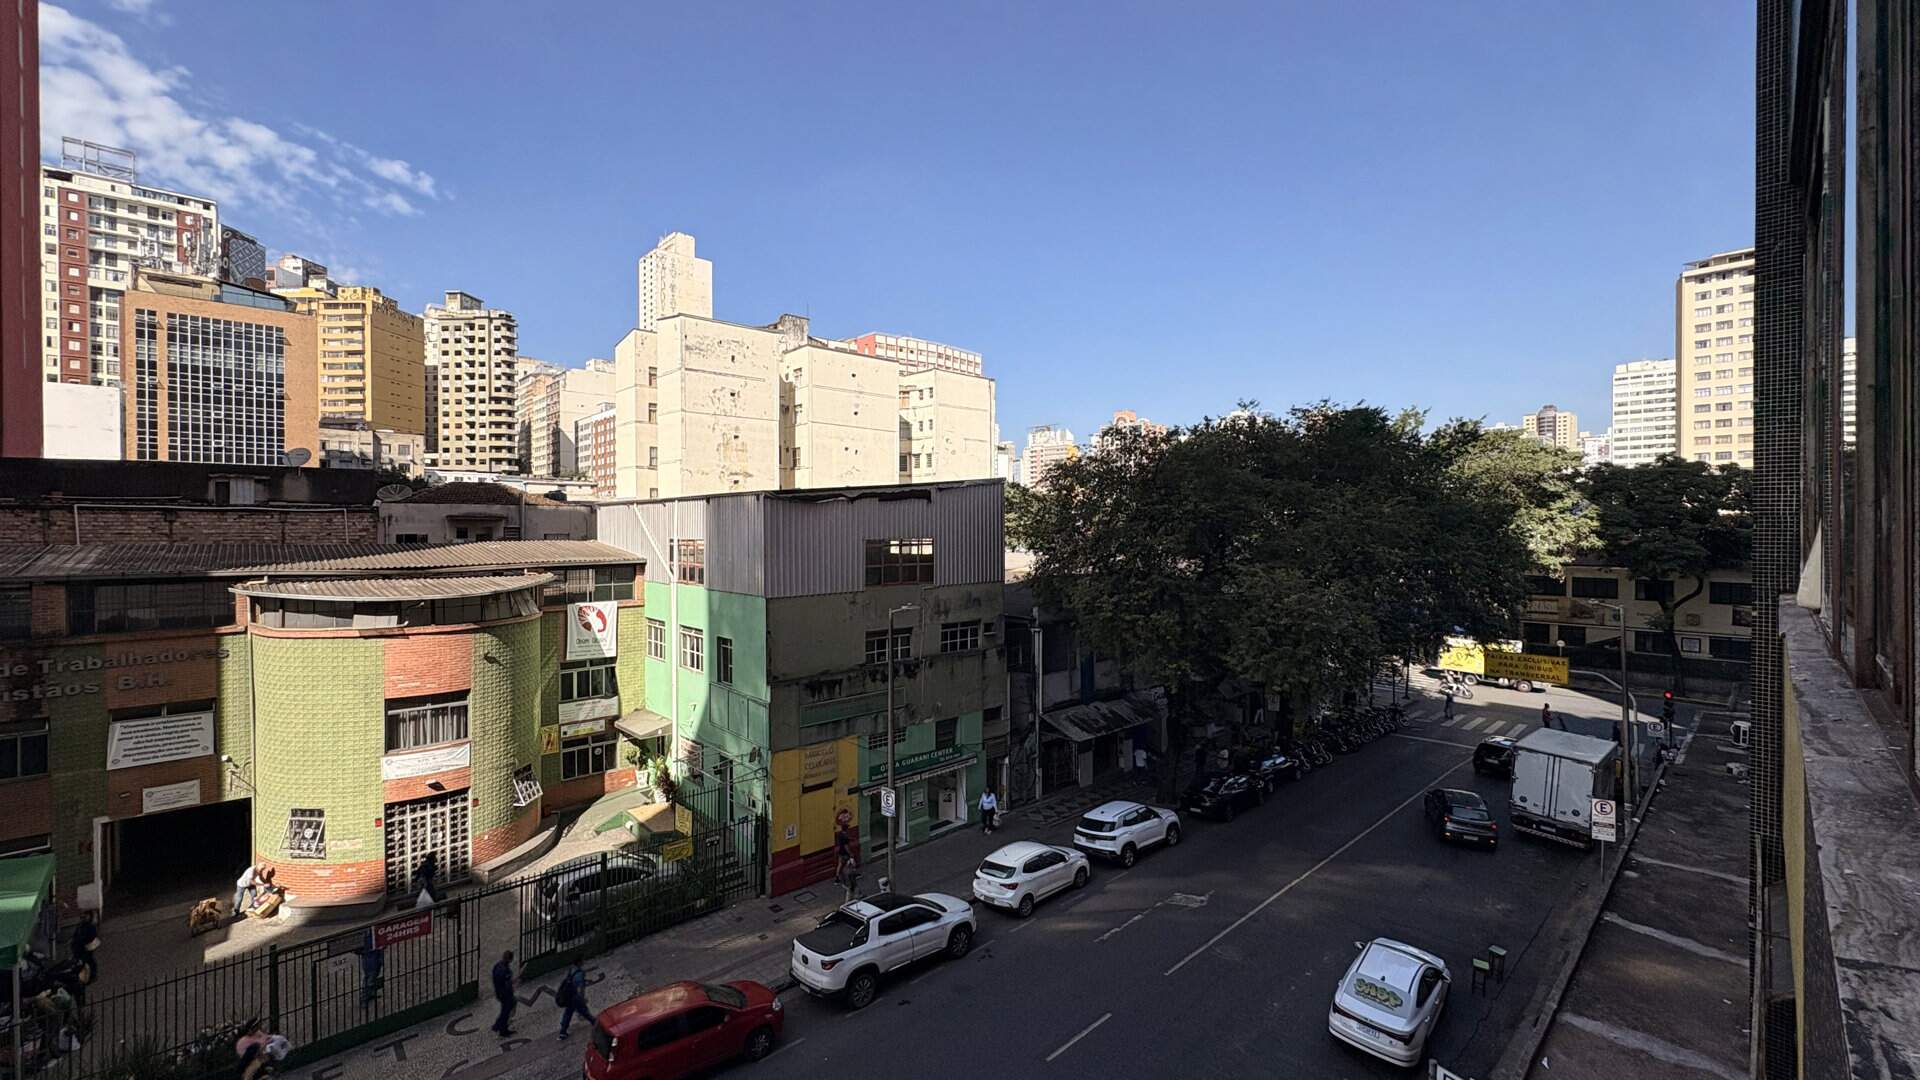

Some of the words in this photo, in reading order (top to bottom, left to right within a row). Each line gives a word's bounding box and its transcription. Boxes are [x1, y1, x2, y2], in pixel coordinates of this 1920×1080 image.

[1600, 803, 1607, 813] E
[378, 916, 429, 936] GARAGEM
[386, 926, 420, 941] 24HRS
